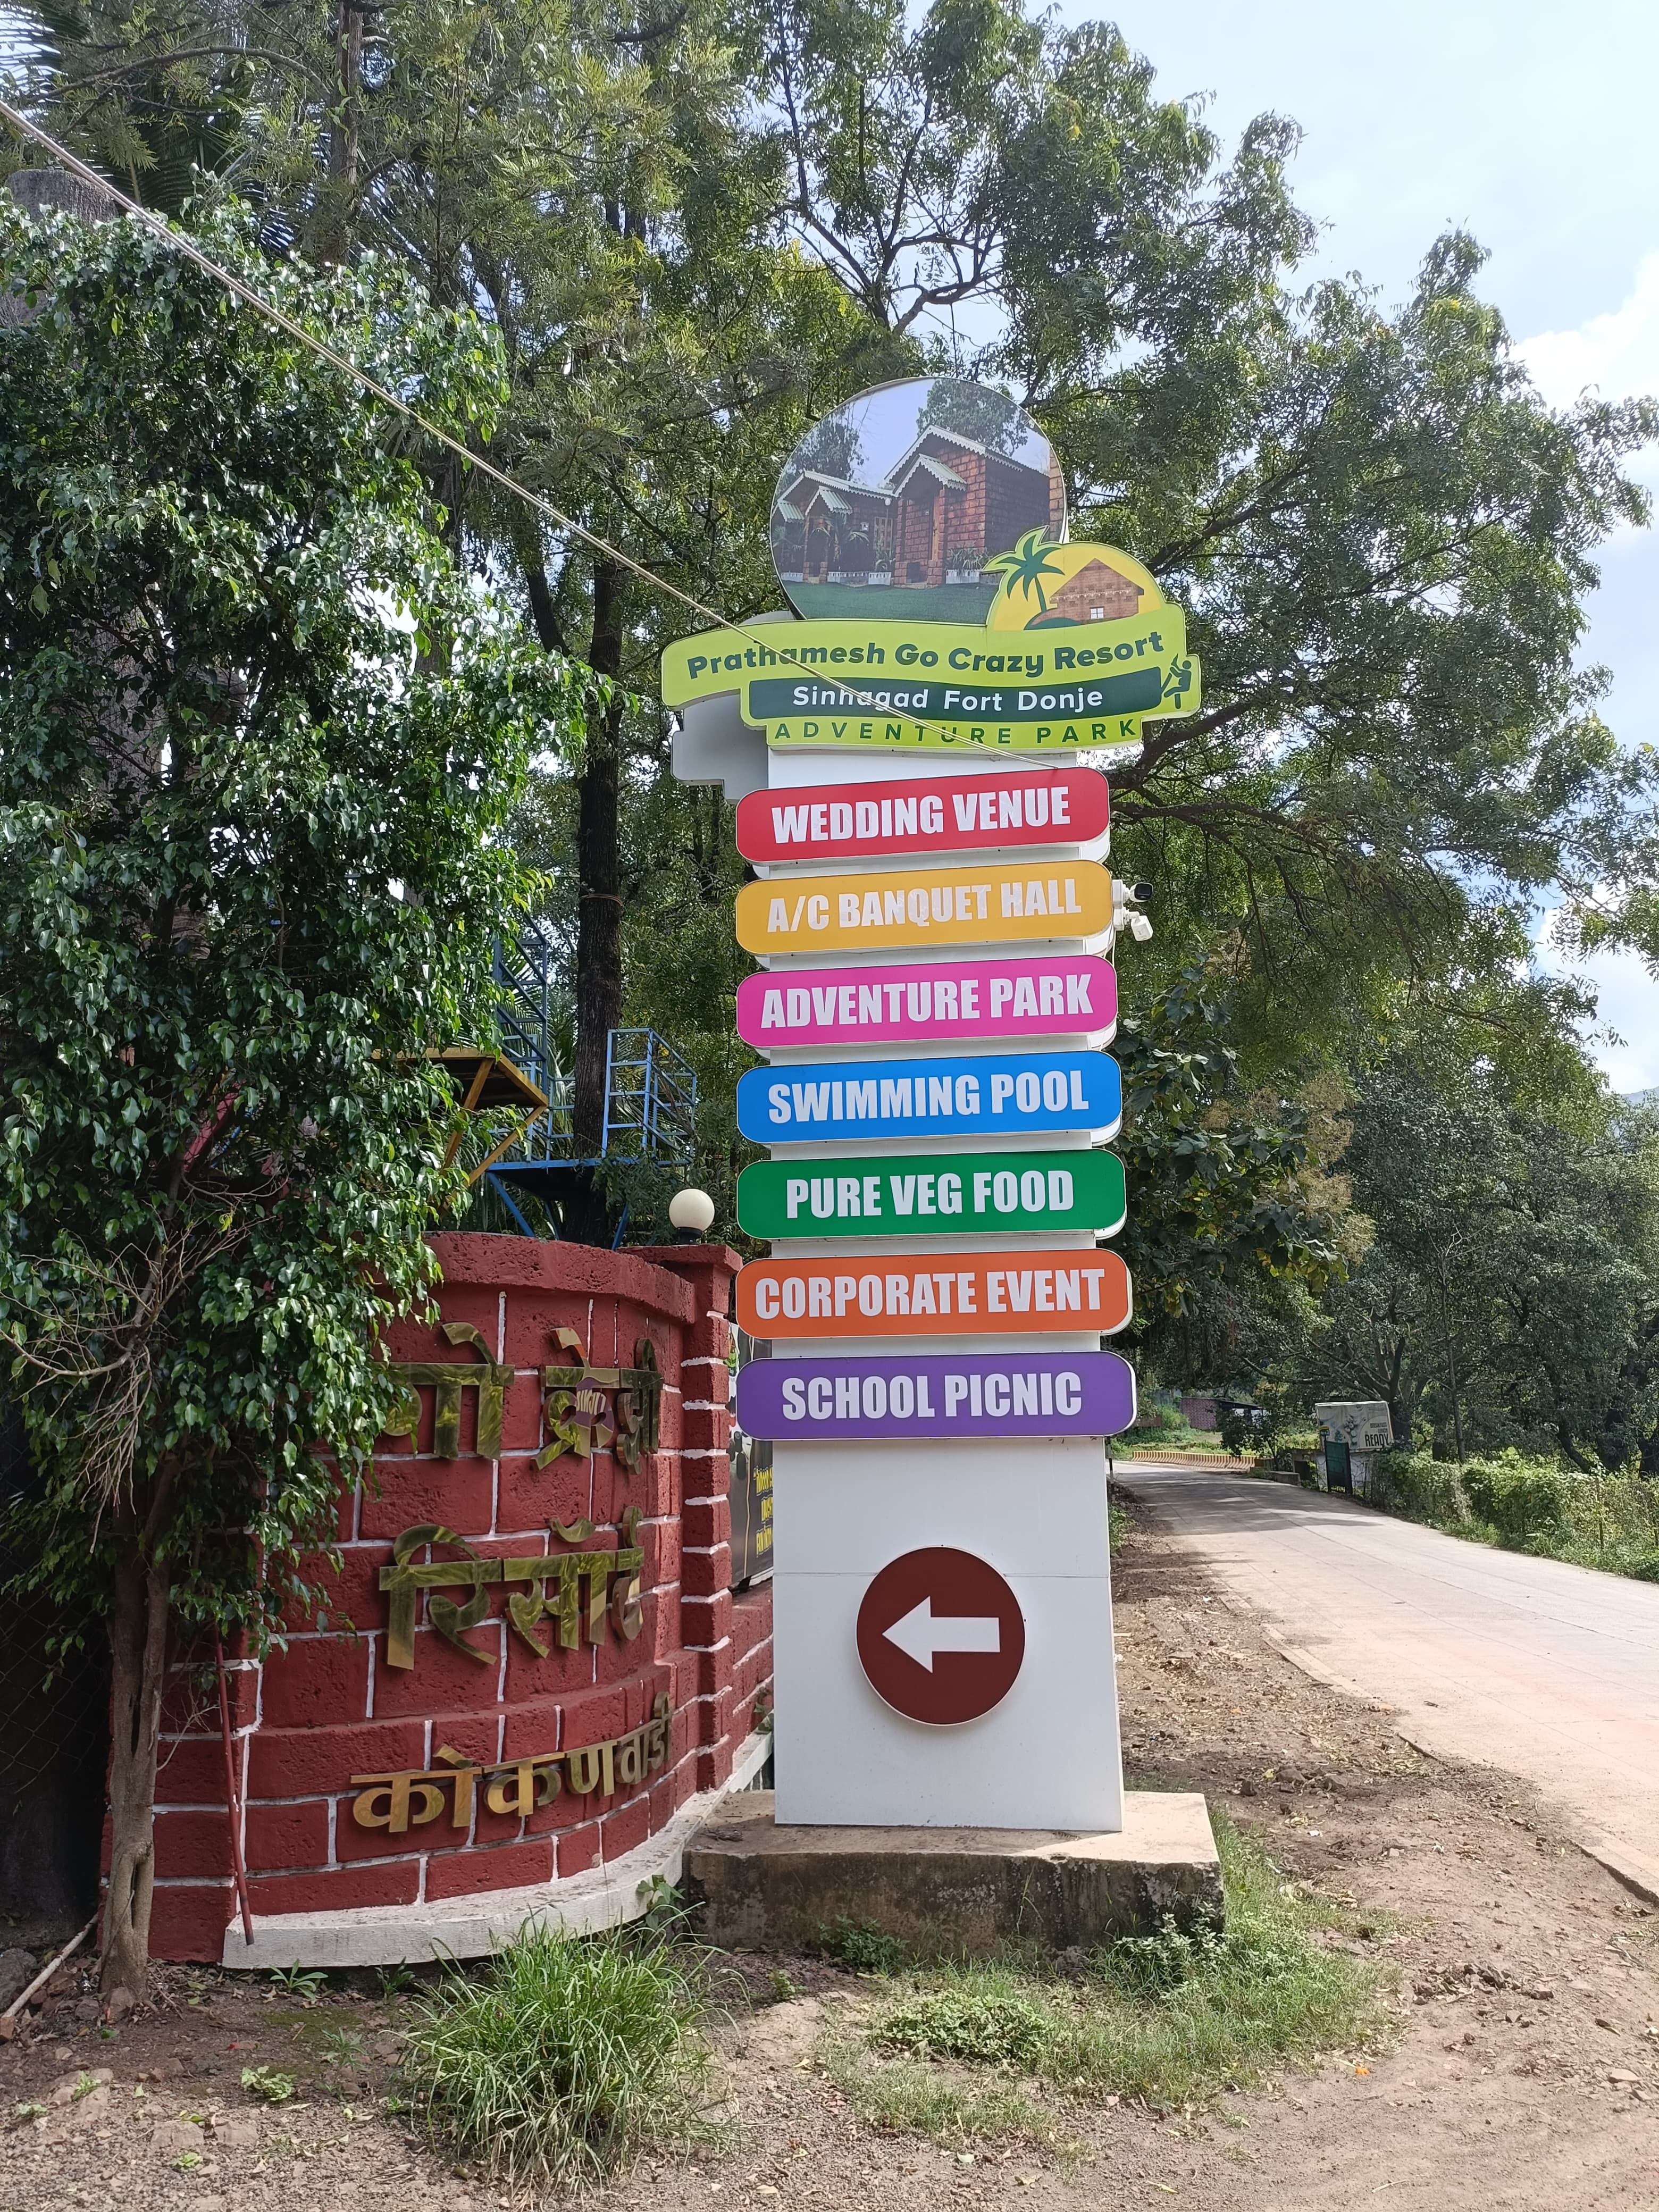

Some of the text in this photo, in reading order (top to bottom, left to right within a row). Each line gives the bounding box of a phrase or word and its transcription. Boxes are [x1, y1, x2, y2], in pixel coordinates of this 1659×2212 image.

[688, 632, 1163, 679] Prathamesh Go Crazy Resort
[793, 686, 1103, 713] Sinhagad Fort Donje
[775, 719, 1136, 743] ADVENTURE PARK
[772, 786, 1070, 844] WEDDING VENUE
[767, 878, 1082, 933] A/C BANQUET HALL
[761, 974, 1093, 1028] ADVENTURE PARK
[769, 1070, 1089, 1124] SWIMMING POOL
[787, 1170, 1074, 1219] PURE VEG FOOD
[755, 1268, 1105, 1319] CORPORATE EVENT
[782, 1371, 1082, 1420] SCHOOL PICNIC
